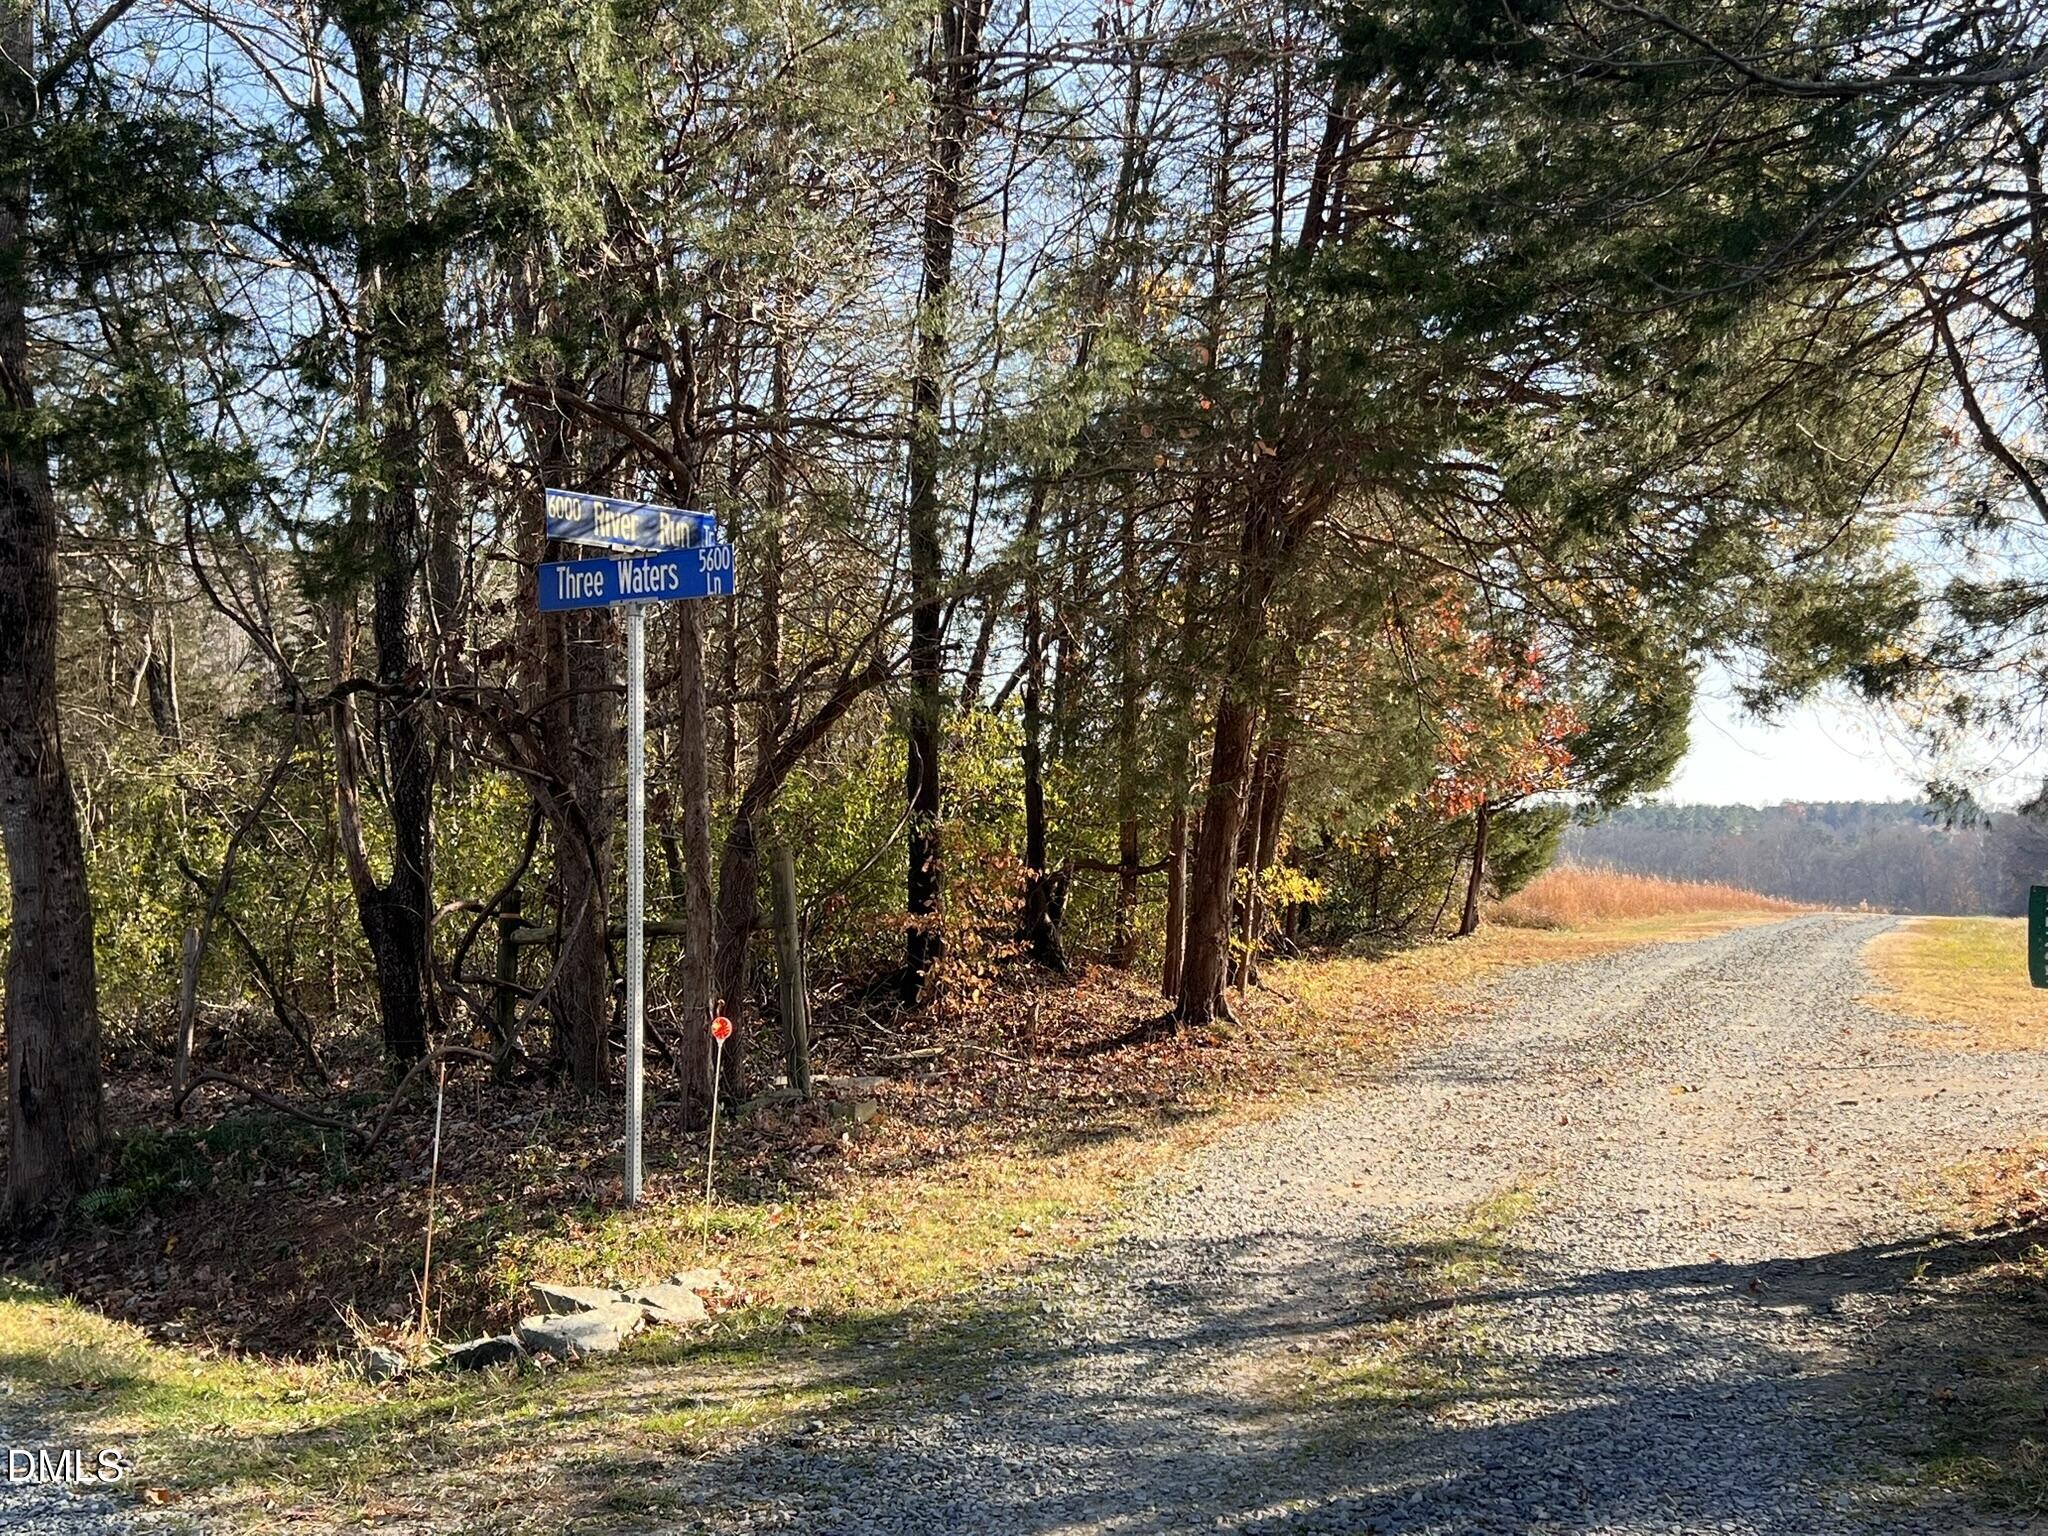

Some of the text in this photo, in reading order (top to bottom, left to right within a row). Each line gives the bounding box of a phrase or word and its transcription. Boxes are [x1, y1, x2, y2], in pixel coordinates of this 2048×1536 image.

[549, 495, 582, 522] 6000
[593, 501, 639, 541] River
[660, 512, 690, 548] Run
[556, 559, 722, 600] Three Waters Ln
[699, 546, 730, 572] 5600
